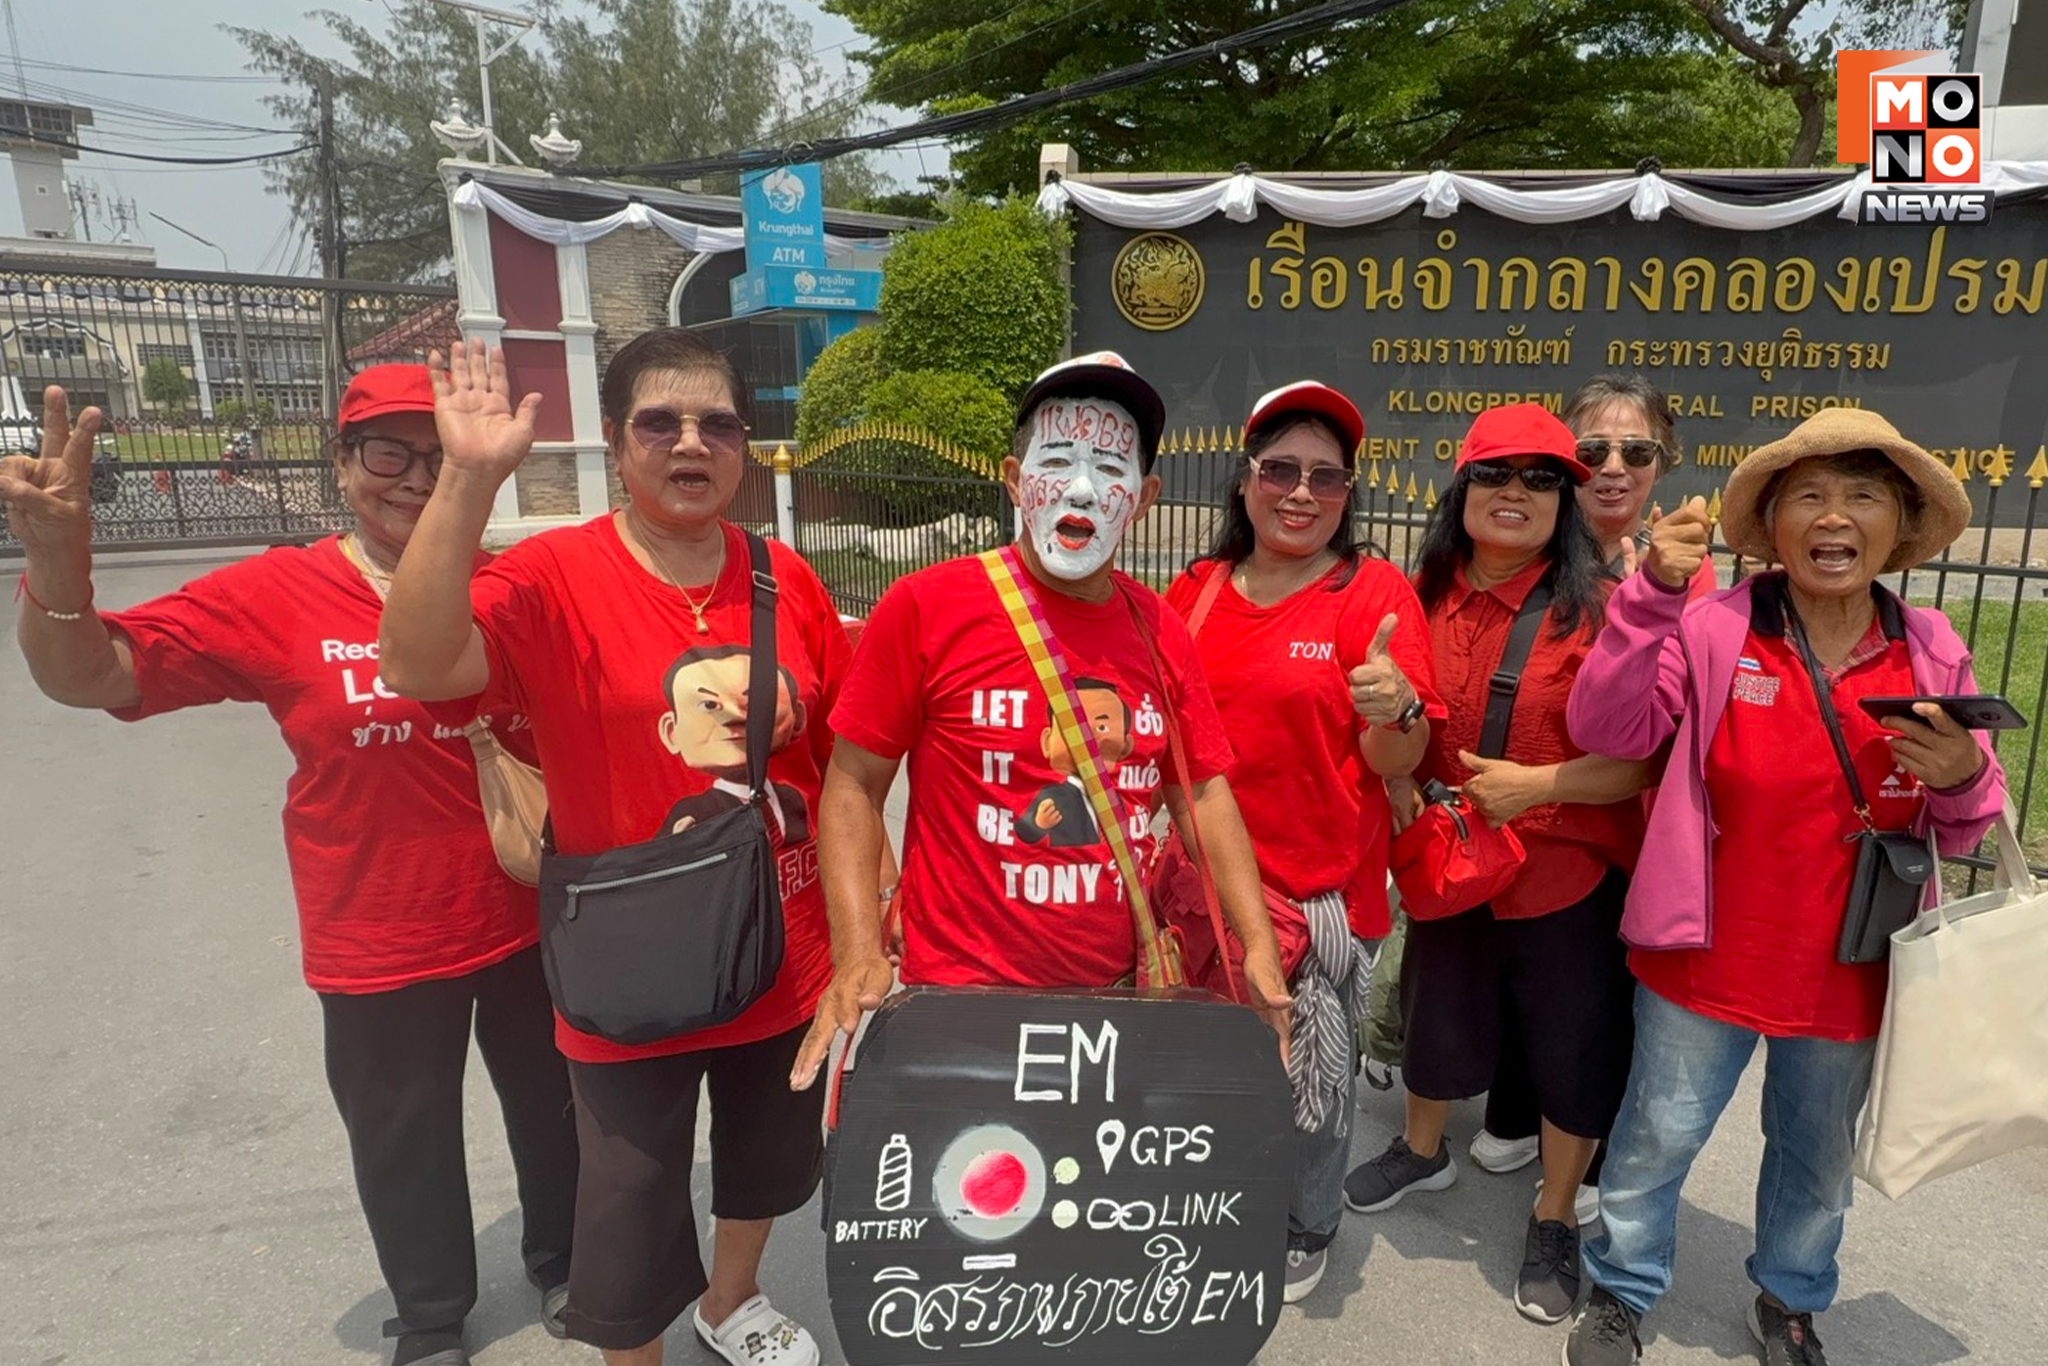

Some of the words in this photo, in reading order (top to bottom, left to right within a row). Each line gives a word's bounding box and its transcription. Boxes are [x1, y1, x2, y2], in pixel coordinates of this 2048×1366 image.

[758, 220, 814, 237] Krungthai
[772, 246, 805, 263] ATM
[1247, 222, 2048, 315] เรือนจำกลางคลองเปรม
[1371, 325, 1575, 365] กรมราชทัณฑ์
[1607, 328, 1891, 381] กระทรวงยุติธรรม
[1733, 685, 1776, 706] PEACE
[1734, 671, 1781, 692] JUSTICE
[972, 689, 1029, 728] LET
[982, 750, 1014, 785] IT
[976, 803, 1014, 847] BE
[1000, 862, 1103, 904] TONY
[1015, 1020, 1119, 1104] EM
[1130, 1124, 1215, 1167] GPS
[1158, 1191, 1242, 1227] LINK
[835, 1217, 929, 1243] BATTERY
[1191, 1271, 1264, 1325] EM
